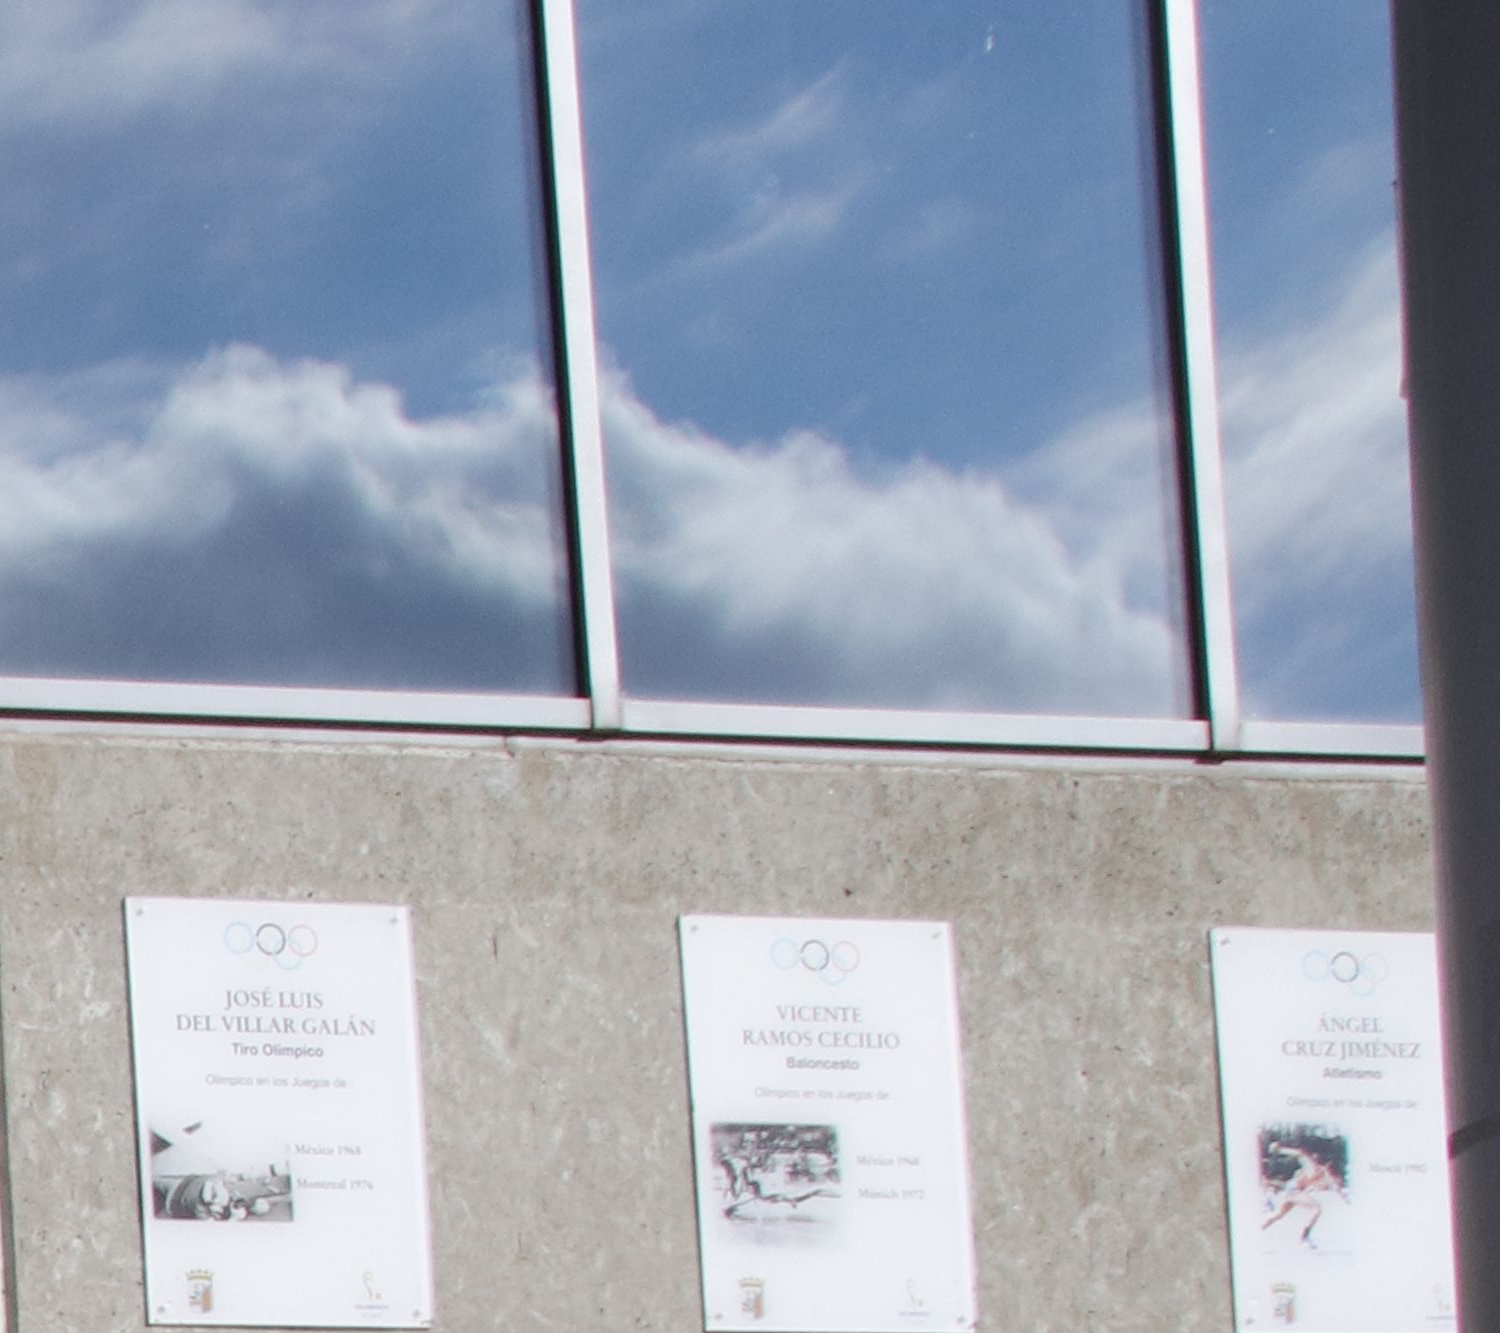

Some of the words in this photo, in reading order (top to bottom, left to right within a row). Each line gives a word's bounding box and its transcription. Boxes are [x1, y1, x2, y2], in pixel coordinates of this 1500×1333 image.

[224, 987, 273, 1010] JOSÉ
[279, 992, 323, 1009] LUIS
[177, 1014, 216, 1031] DEL
[221, 1016, 296, 1034] VILLAR
[302, 1015, 375, 1035] GALÁN
[776, 1005, 862, 1023] VICENTE
[1318, 1012, 1384, 1033] ÁNGEL
[743, 1030, 813, 1047] RAMOS
[818, 1032, 900, 1049] CECILIO
[1282, 1040, 1336, 1057] CRUZ
[1340, 1038, 1420, 1061] JIMÉNEZ
[232, 1042, 258, 1056] Tiro
[262, 1043, 324, 1060] Olímpico
